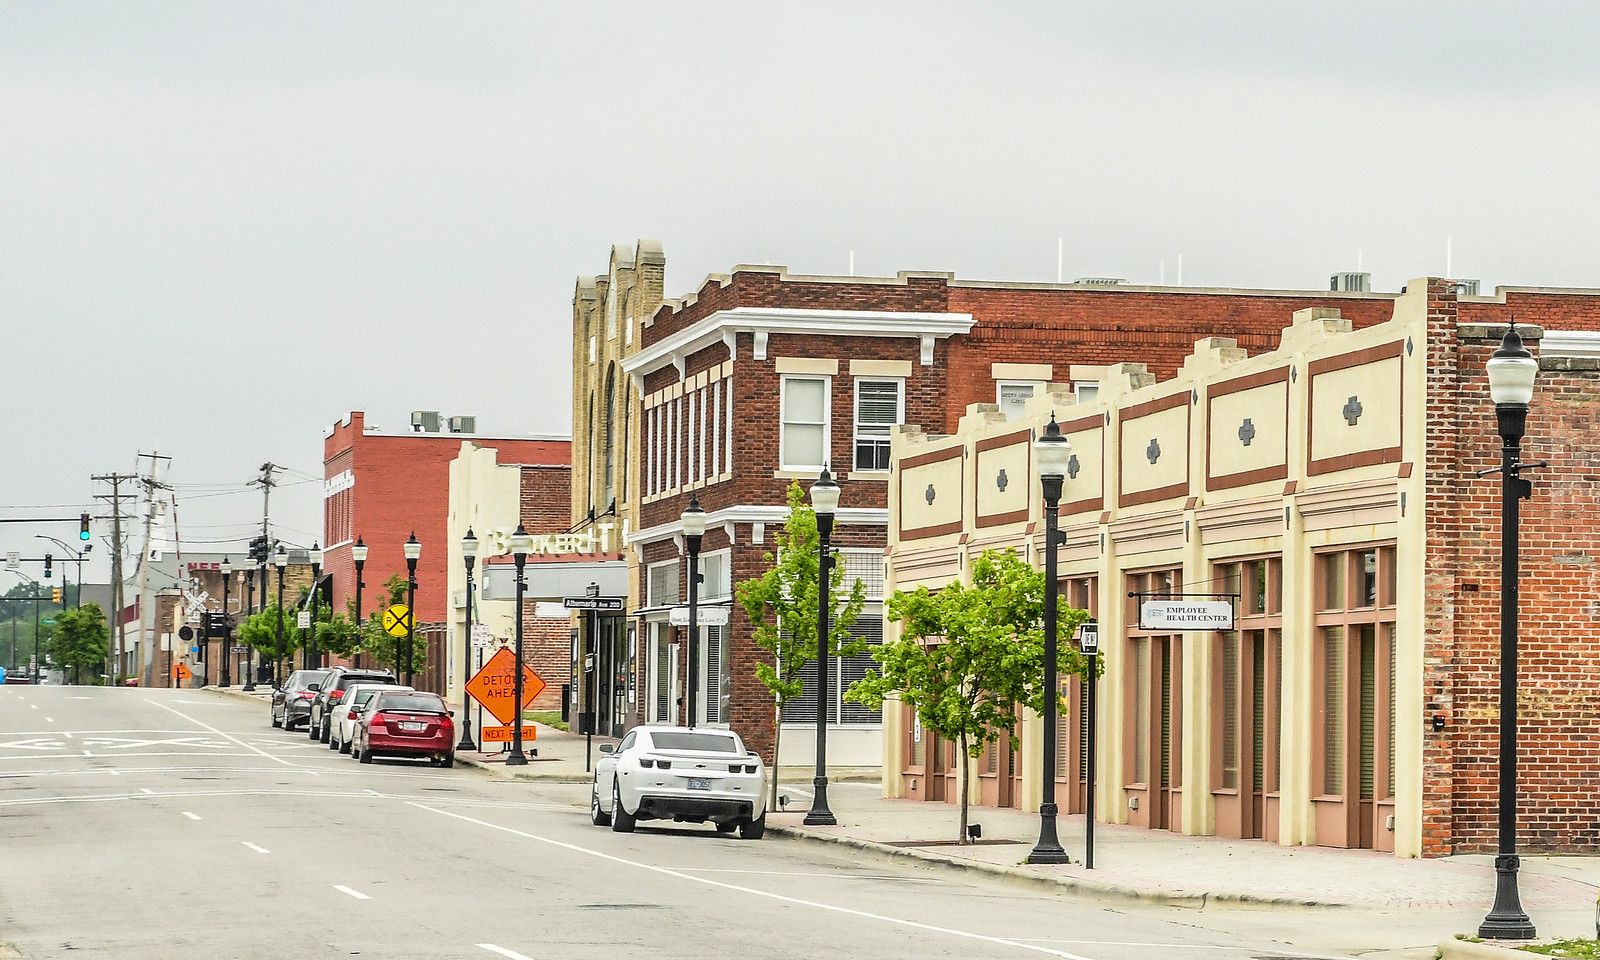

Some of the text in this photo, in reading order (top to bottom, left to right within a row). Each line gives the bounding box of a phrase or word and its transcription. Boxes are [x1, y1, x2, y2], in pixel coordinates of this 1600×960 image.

[1166, 606, 1208, 614] EMPLOYEE
[1166, 614, 1196, 622] HEALTH
[487, 688, 525, 699] AHEA
[485, 728, 533, 739] NEXT RHT
